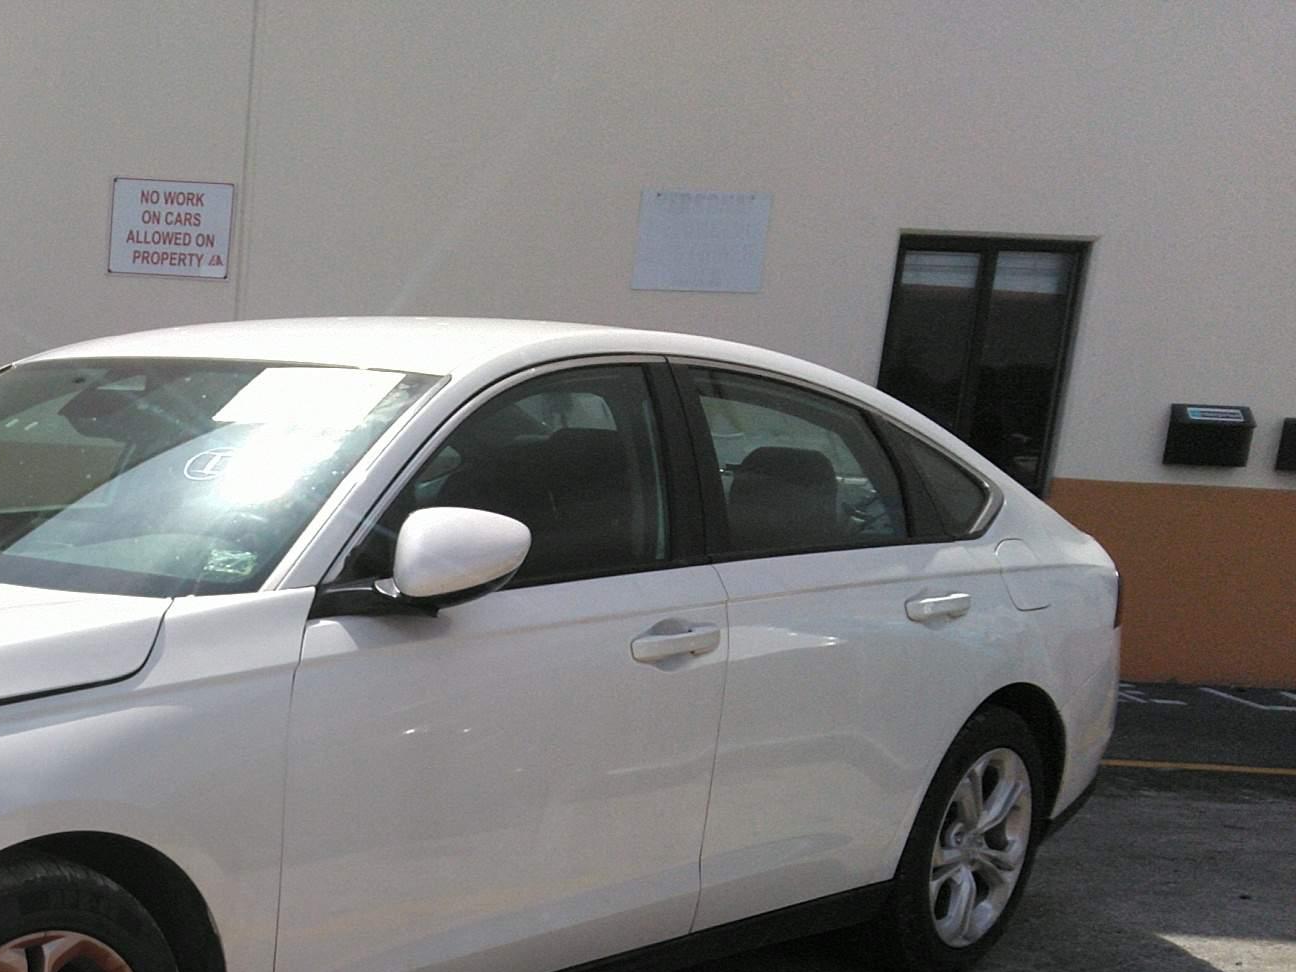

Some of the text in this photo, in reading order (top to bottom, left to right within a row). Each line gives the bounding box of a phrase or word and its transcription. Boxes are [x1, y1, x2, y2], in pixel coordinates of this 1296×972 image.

[140, 190, 204, 207] NO WORK
[141, 210, 202, 227] ON CARS
[126, 229, 215, 248] ALLOWED ON
[132, 250, 204, 268] PROPERTY
